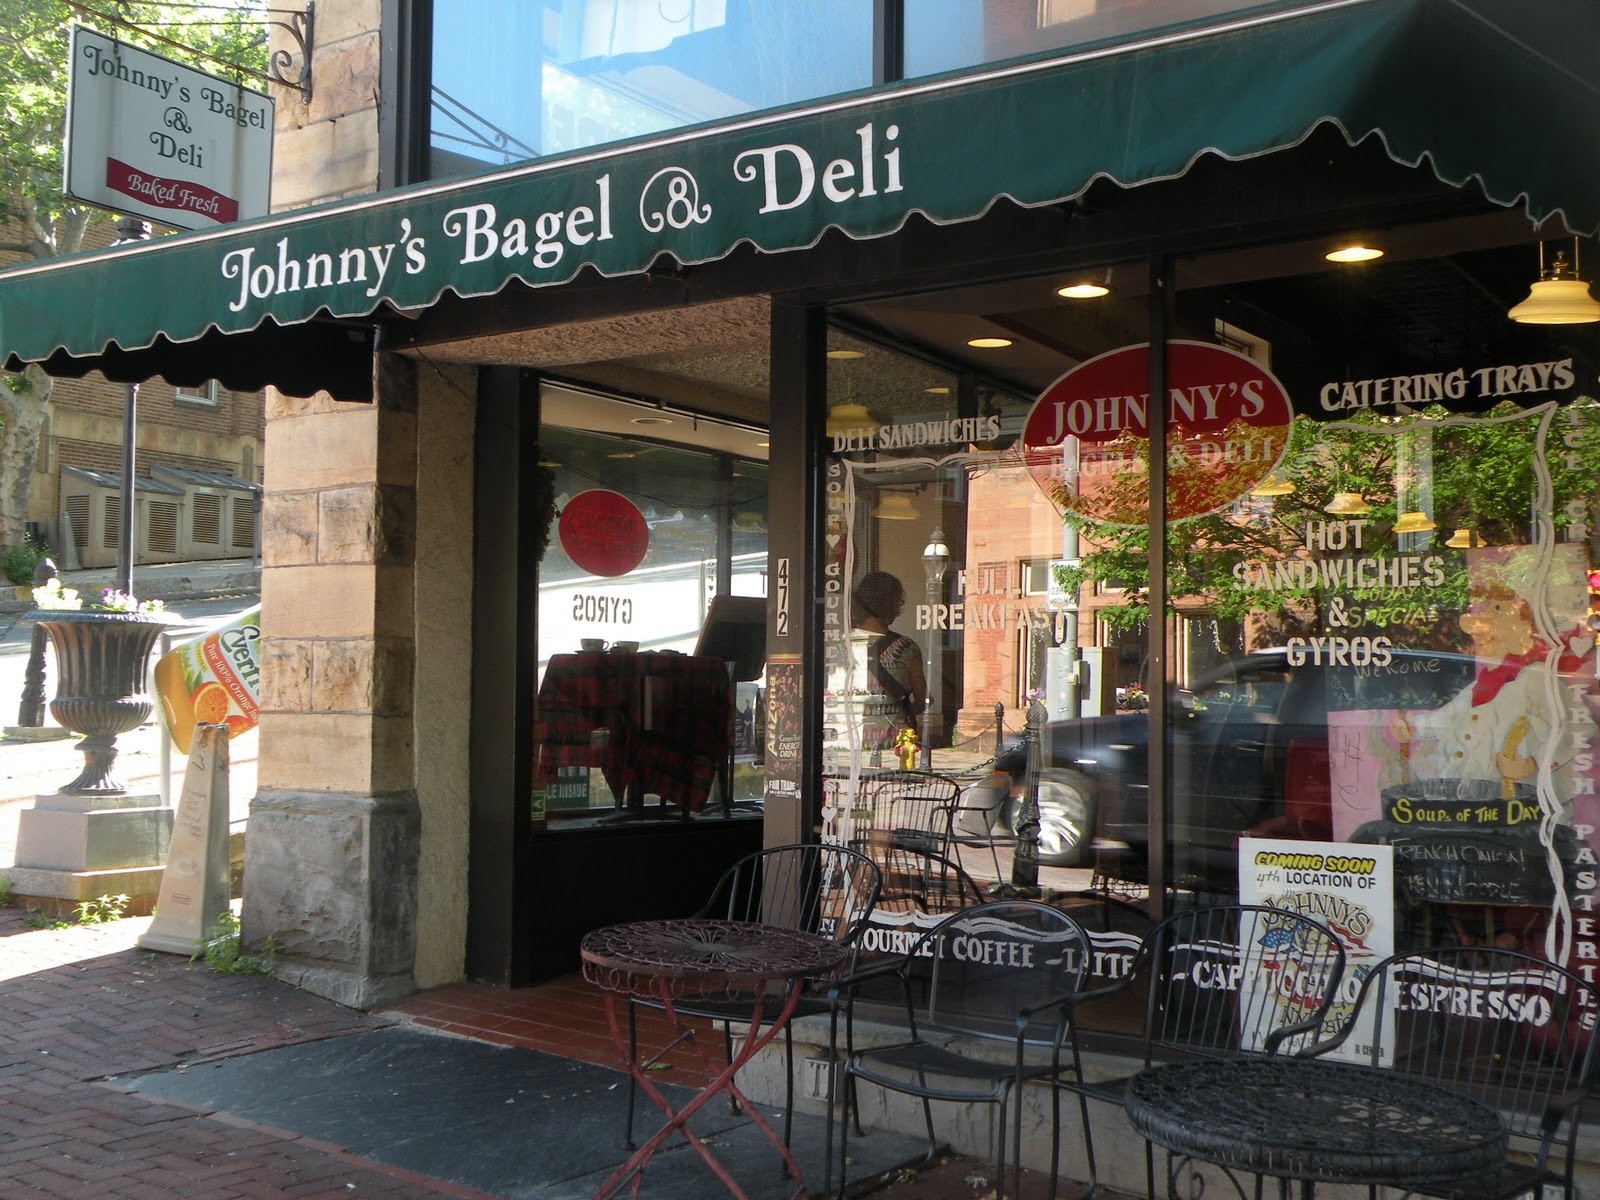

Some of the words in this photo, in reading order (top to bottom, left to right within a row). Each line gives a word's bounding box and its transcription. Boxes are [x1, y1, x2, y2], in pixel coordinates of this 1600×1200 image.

[83, 45, 190, 103] Johnny's
[200, 87, 266, 130] Bagel
[163, 106, 192, 134] &
[150, 131, 203, 169] Deli
[128, 173, 179, 204] Baked
[178, 184, 220, 214] Fresh
[221, 218, 426, 312] Johnny's
[443, 173, 614, 269] Bagel
[639, 166, 712, 234] &
[733, 122, 904, 215] Deli
[1319, 368, 1470, 411] CATERING
[1470, 357, 1575, 398] TRAYS
[1046, 379, 1264, 444] JOHNNY'S
[832, 427, 876, 453] DELI
[879, 415, 1001, 449] SANDWICHES
[1166, 443, 1189, 469] &
[1200, 436, 1274, 466] DELI
[1306, 519, 1368, 551] HOT
[1232, 556, 1445, 592] SANDWICHES
[778, 560, 788, 635] 472
[1329, 597, 1349, 627] &
[915, 603, 1065, 634] BREAKFAST
[1286, 636, 1392, 667] GYROS
[229, 682, 253, 711] Orange
[1567, 683, 1595, 796] FRESH
[1456, 808, 1472, 822] OF
[1475, 807, 1499, 823] THE
[1507, 800, 1541, 825] DAY
[1255, 851, 1324, 870] COMING
[1325, 855, 1377, 874] SOON
[1286, 871, 1353, 888] LOCATION
[1357, 877, 1377, 889] OF
[1573, 824, 1599, 1034] PASTERIES
[952, 935, 1035, 968] COFFEE
[1393, 981, 1551, 1027] ESPRESSO
[1362, 1045, 1385, 1058] CENER
